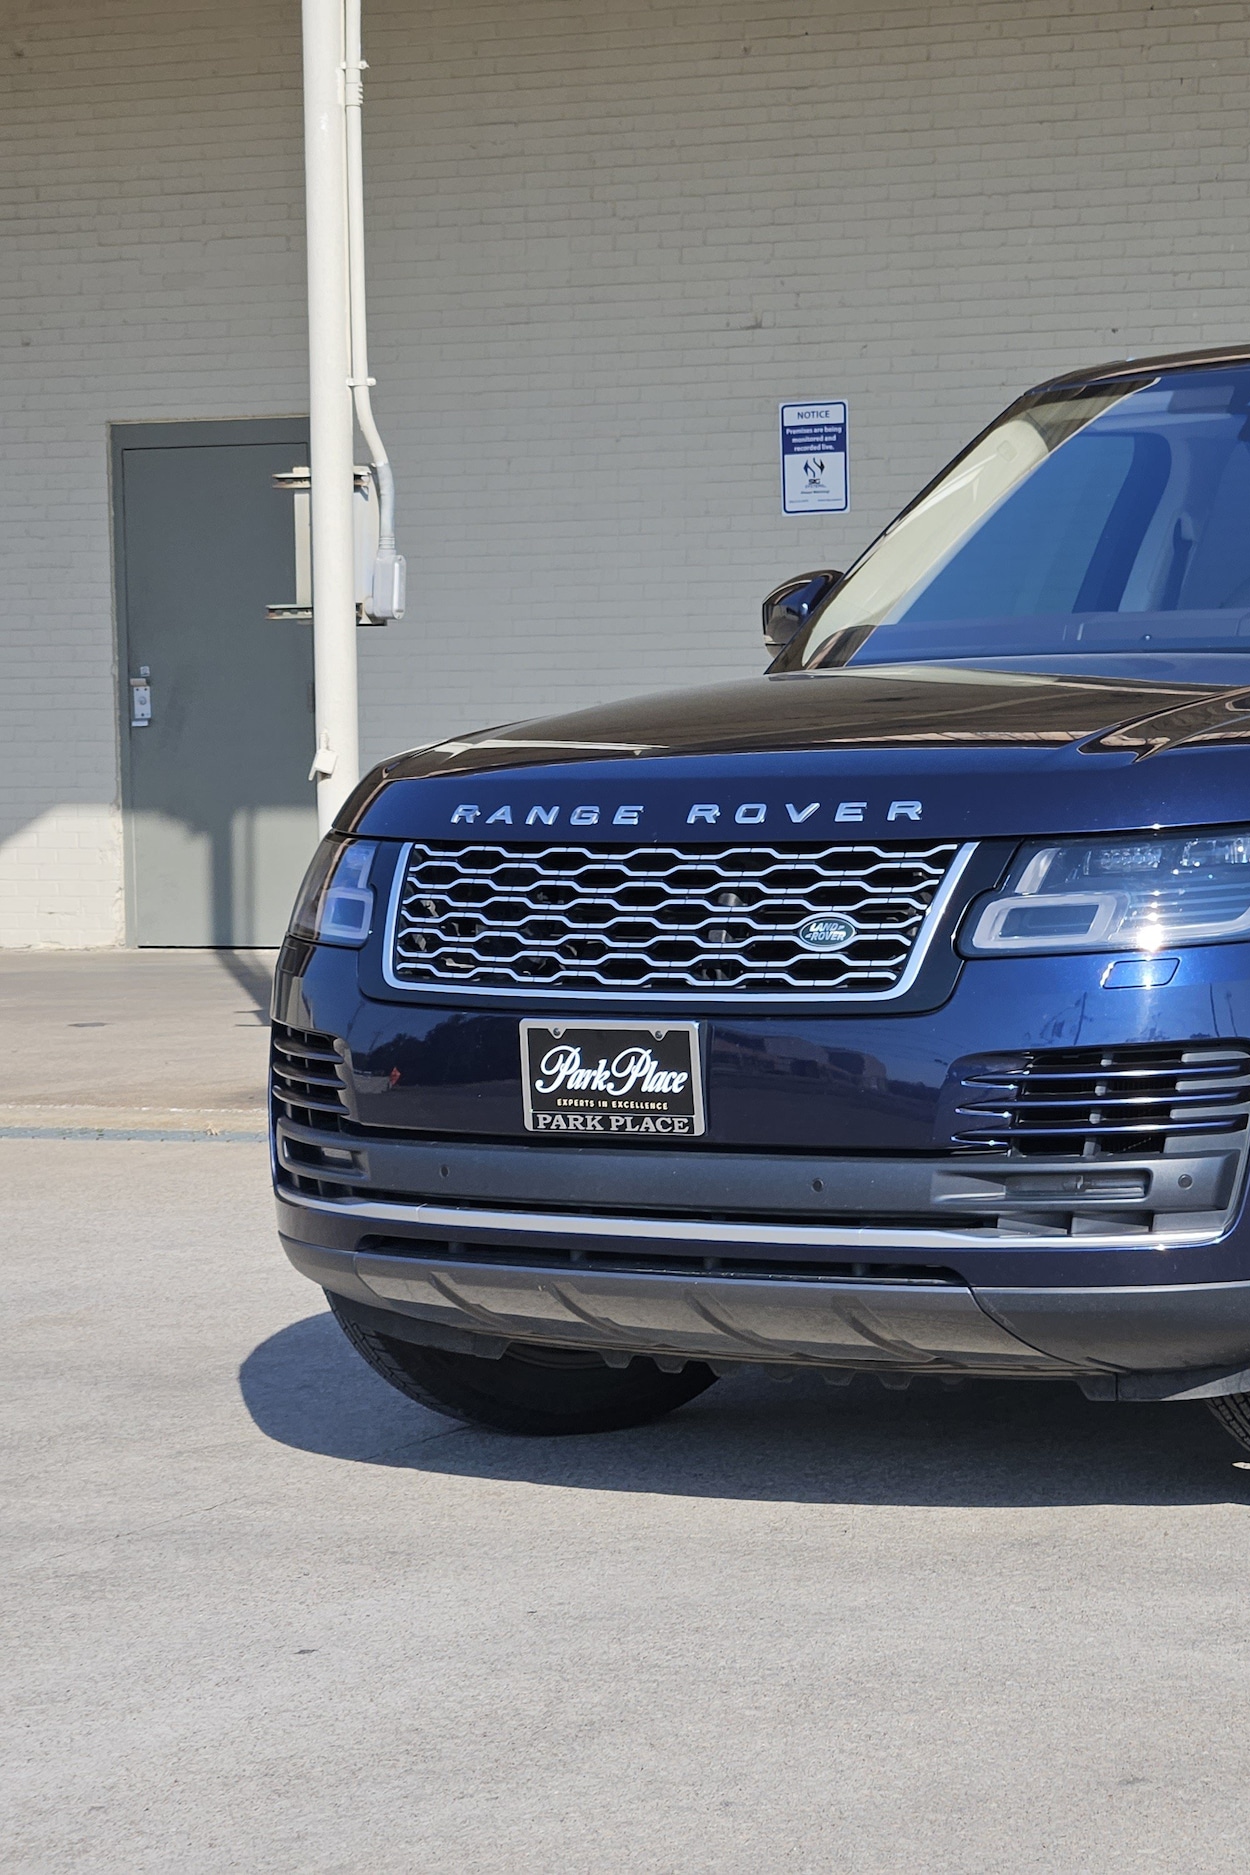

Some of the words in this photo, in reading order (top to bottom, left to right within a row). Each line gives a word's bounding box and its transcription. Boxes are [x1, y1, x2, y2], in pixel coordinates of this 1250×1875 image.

[797, 410, 830, 420] NOTICE
[824, 426, 842, 434] being
[824, 434, 837, 442] and
[450, 804, 644, 825] RANGE
[686, 800, 923, 824] ROVER
[810, 923, 838, 931] LAND
[811, 931, 846, 940] ROVER
[535, 1045, 611, 1094] Park
[606, 1047, 689, 1096] Place
[556, 1098, 595, 1108] EXPERTS
[598, 1099, 608, 1108] IN
[611, 1100, 669, 1111] EXCELLENCE
[536, 1114, 605, 1132] PARK
[609, 1116, 690, 1134] PLACE
